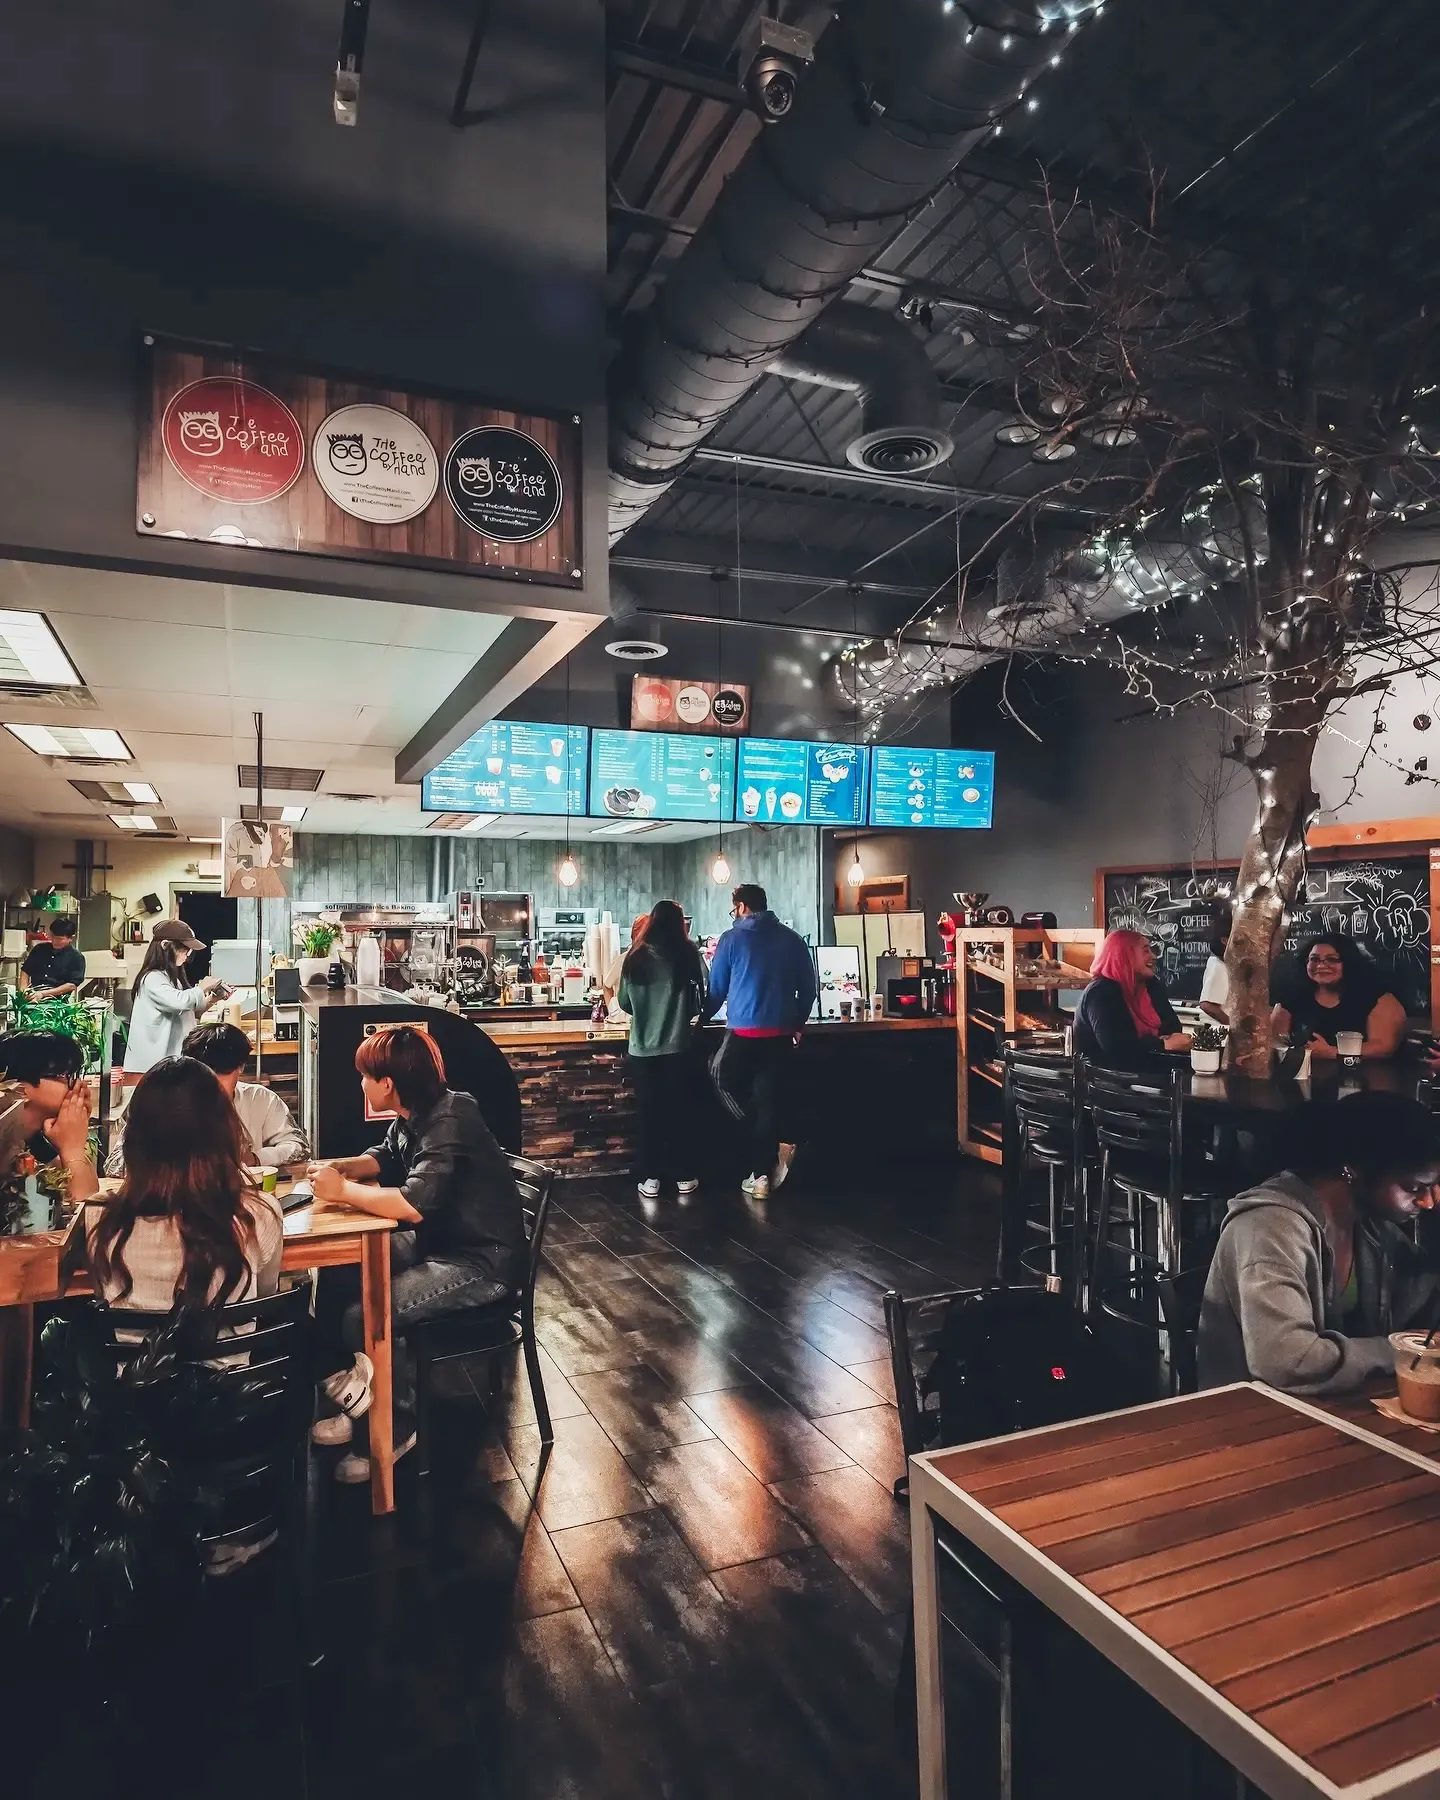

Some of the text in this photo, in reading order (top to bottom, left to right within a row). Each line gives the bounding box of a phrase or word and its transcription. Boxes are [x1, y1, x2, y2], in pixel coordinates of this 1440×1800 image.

[229, 415, 256, 429] Te
[260, 441, 289, 457] and
[394, 461, 426, 476] Hand
[497, 460, 520, 473] Te
[523, 484, 546, 497] and
[1385, 906, 1413, 926] TRY
[1391, 923, 1413, 939] ME!
